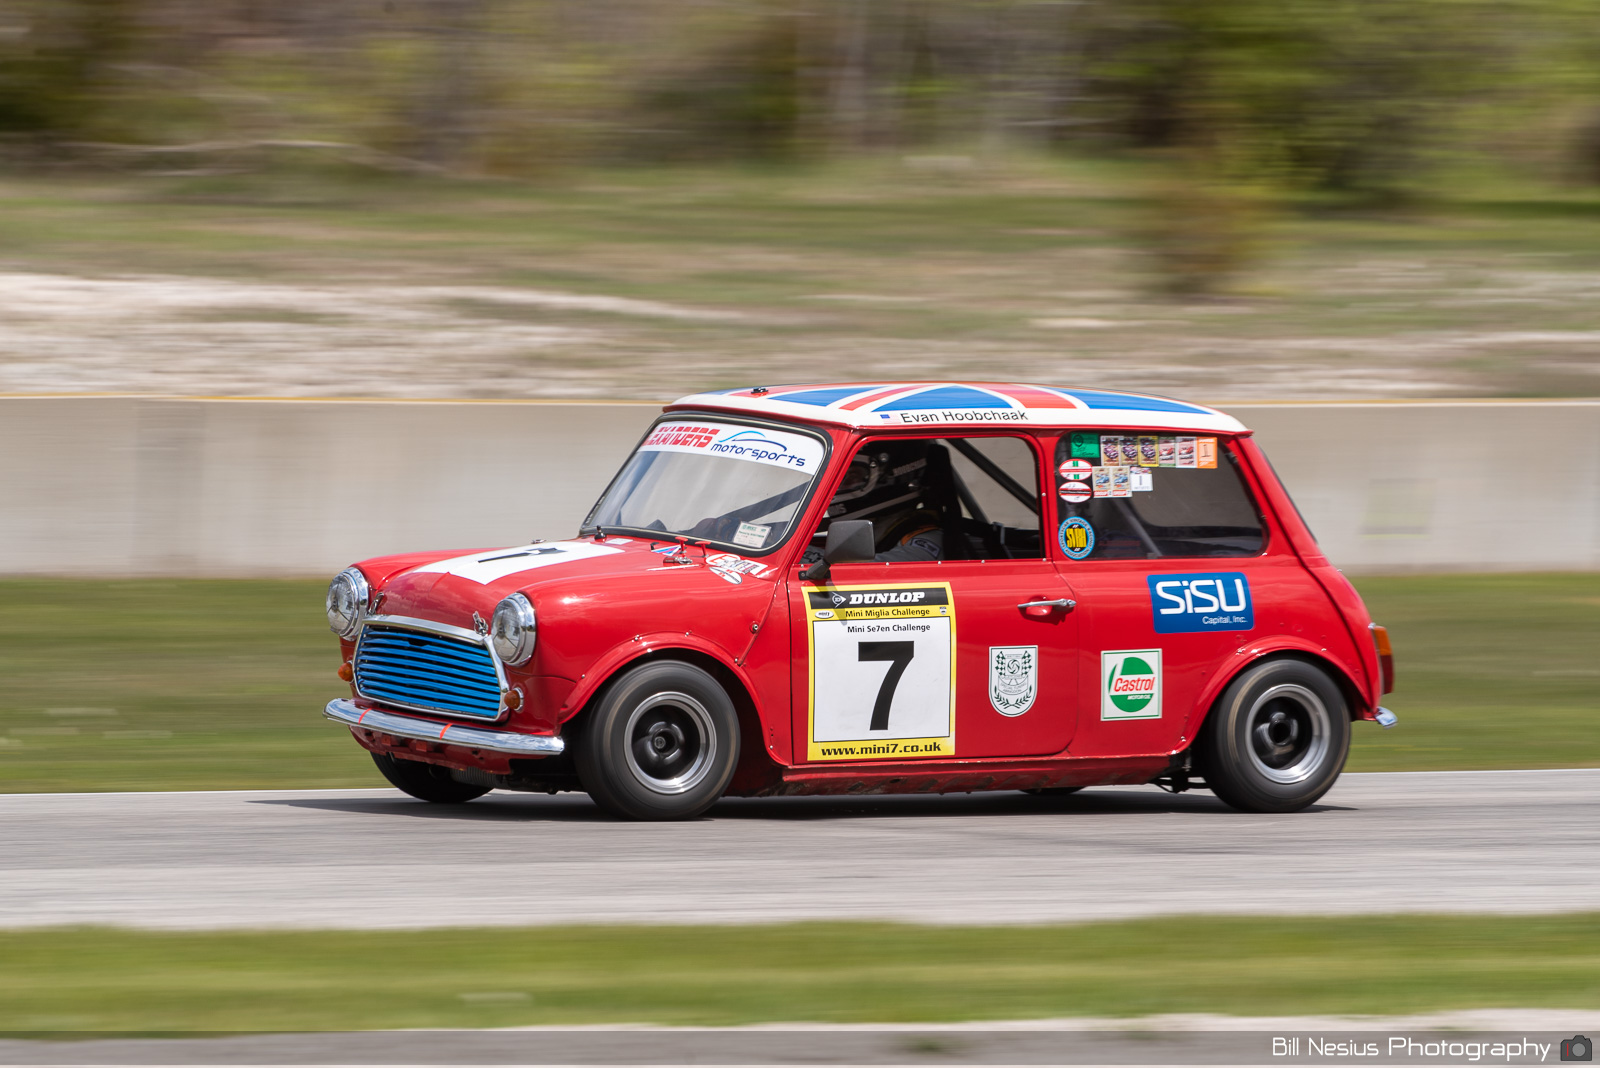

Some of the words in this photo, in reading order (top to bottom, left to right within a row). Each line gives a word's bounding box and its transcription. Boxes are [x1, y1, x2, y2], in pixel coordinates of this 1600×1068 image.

[900, 412, 940, 424] Evan
[942, 410, 1029, 422] Hoobchaak
[710, 443, 806, 467] motorsports
[849, 591, 925, 605] DUNLOP
[845, 609, 863, 618] Mini
[865, 608, 890, 619] Miglia
[891, 607, 930, 617] Challenge
[847, 625, 865, 633] Mini
[867, 624, 890, 633] Se7en
[892, 623, 931, 633] Challenge
[858, 640, 915, 731] 7
[1113, 676, 1156, 693] Castrol
[821, 742, 942, 756] www.mini7.co.uk
